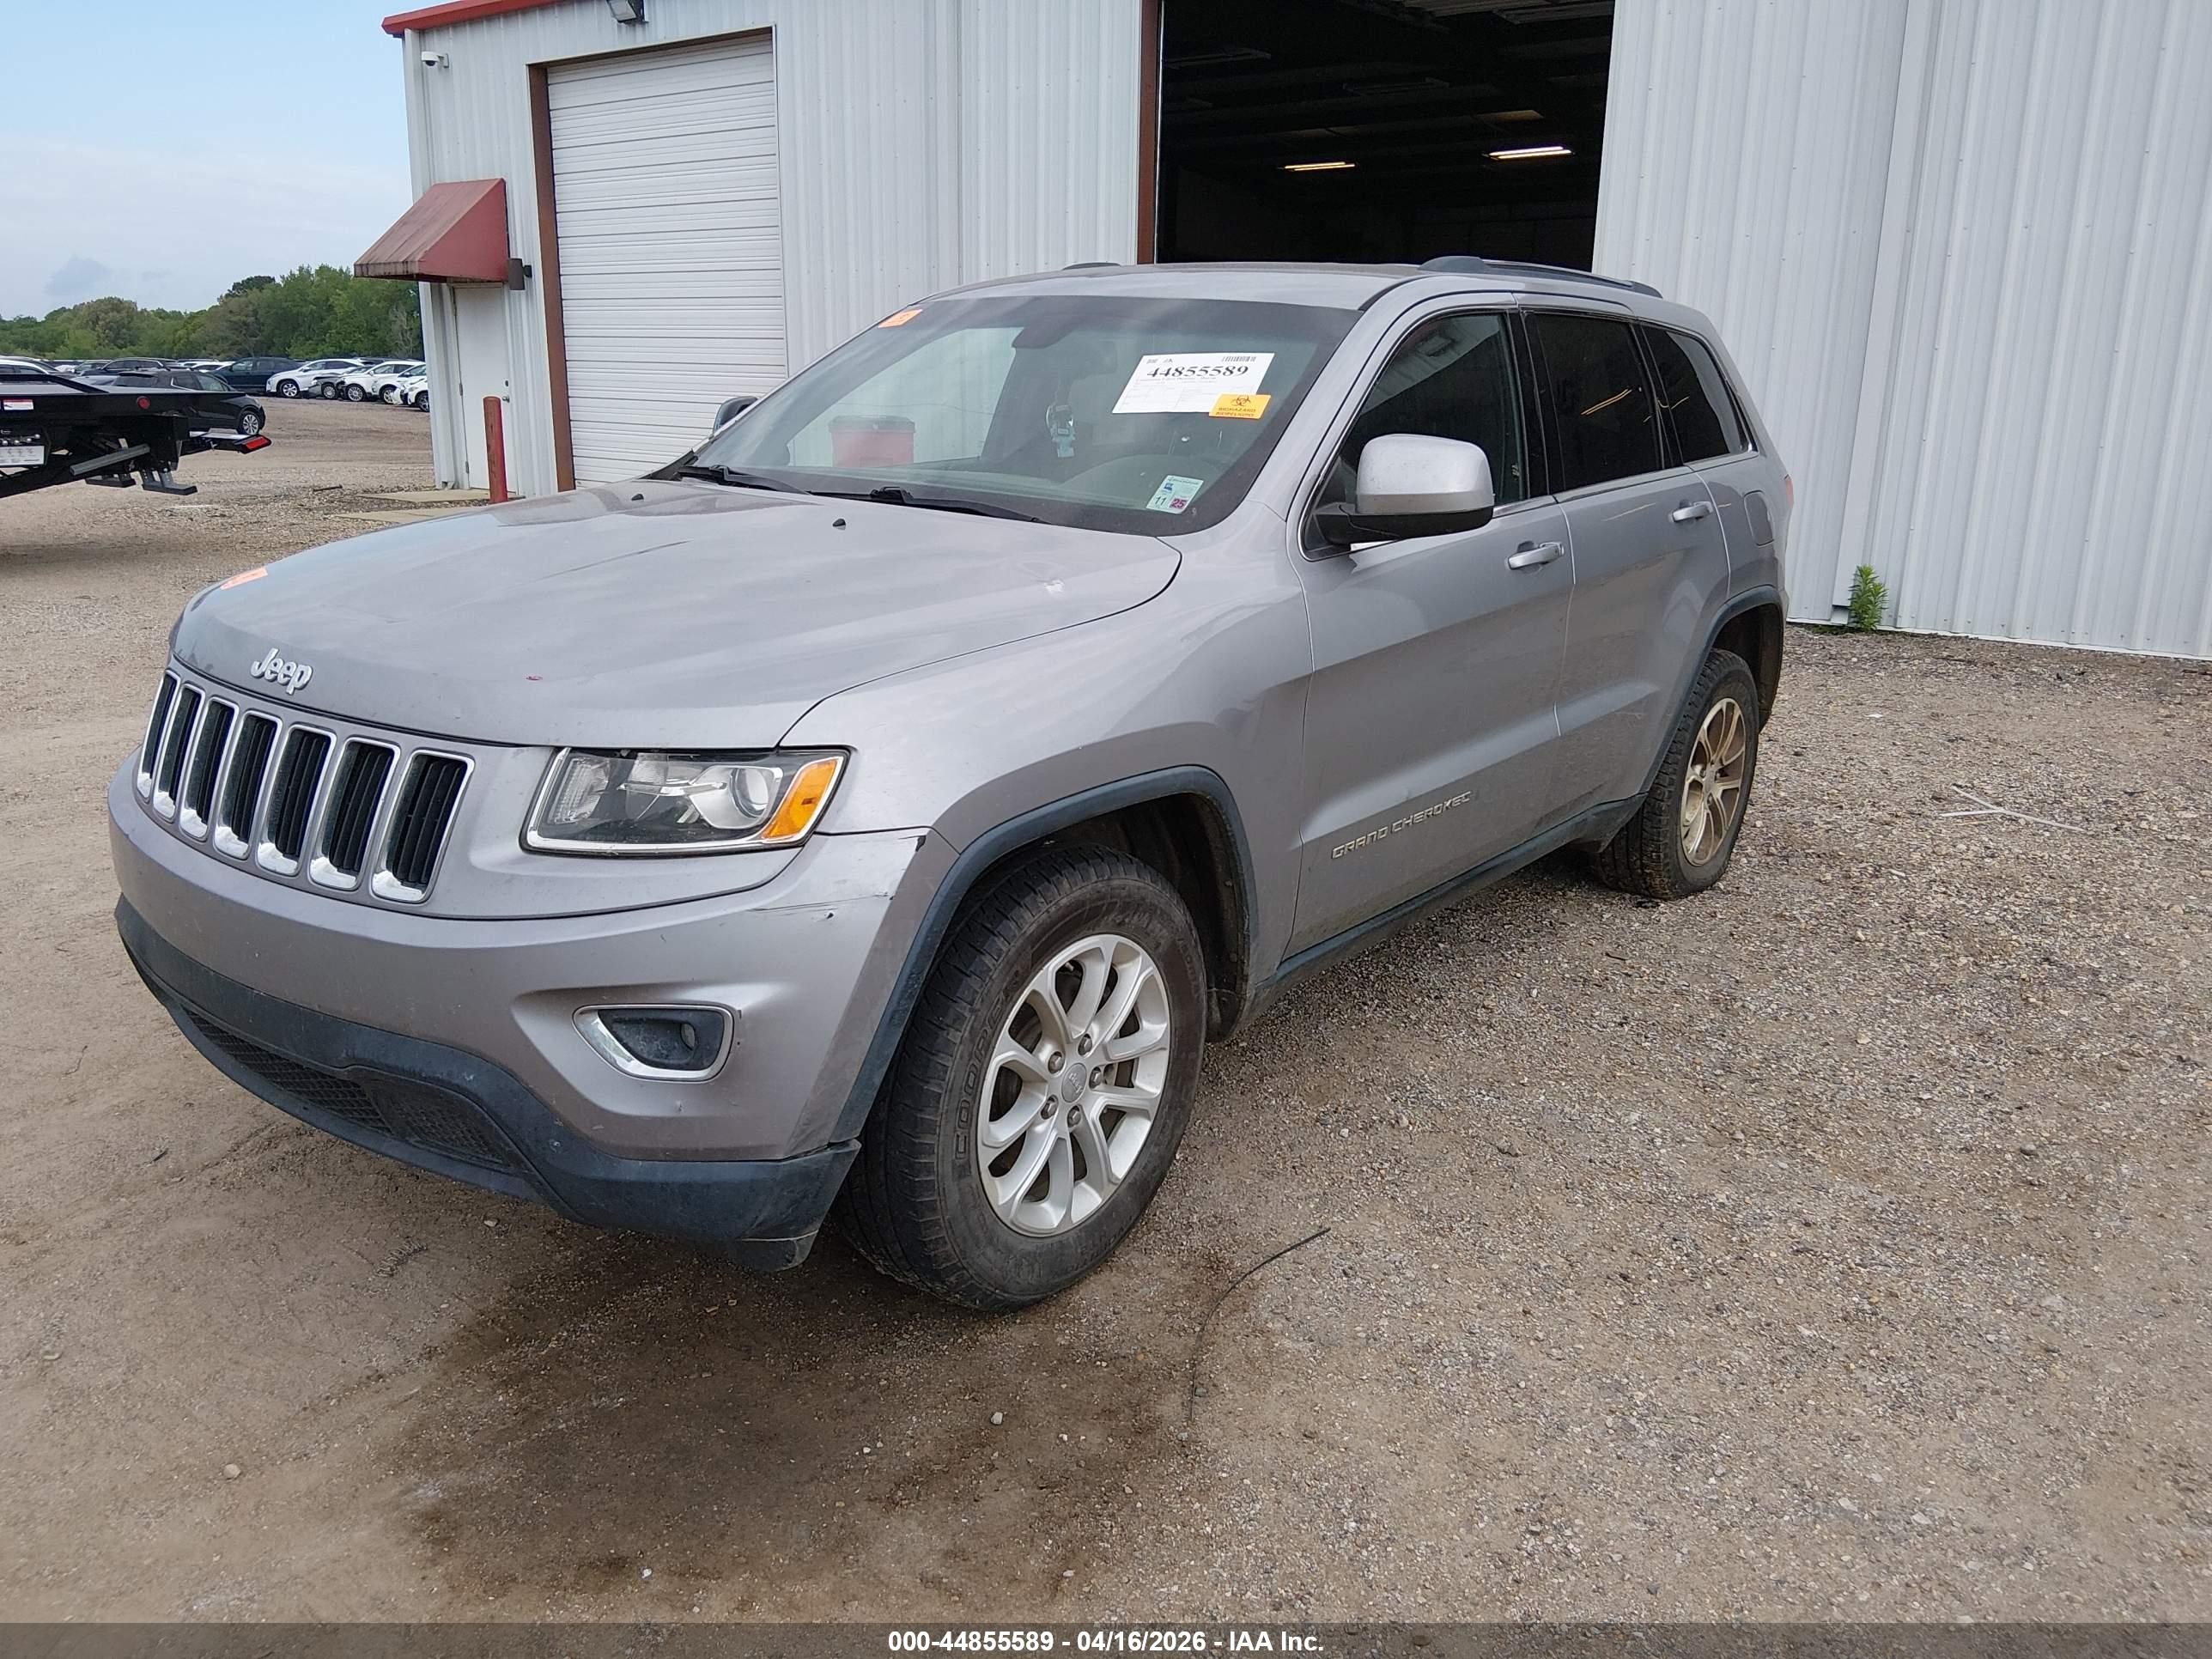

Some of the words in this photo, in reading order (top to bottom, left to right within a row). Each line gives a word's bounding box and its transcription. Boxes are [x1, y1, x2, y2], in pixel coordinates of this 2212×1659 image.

[1146, 366, 1249, 378] 44855589
[1155, 496, 1167, 506] 11
[1170, 498, 1188, 508] 25
[250, 647, 313, 696] Jeep
[1331, 826, 1389, 859] GRAND
[1391, 791, 1472, 834] CHEROKEE
[955, 969, 1020, 1159] COOPE
